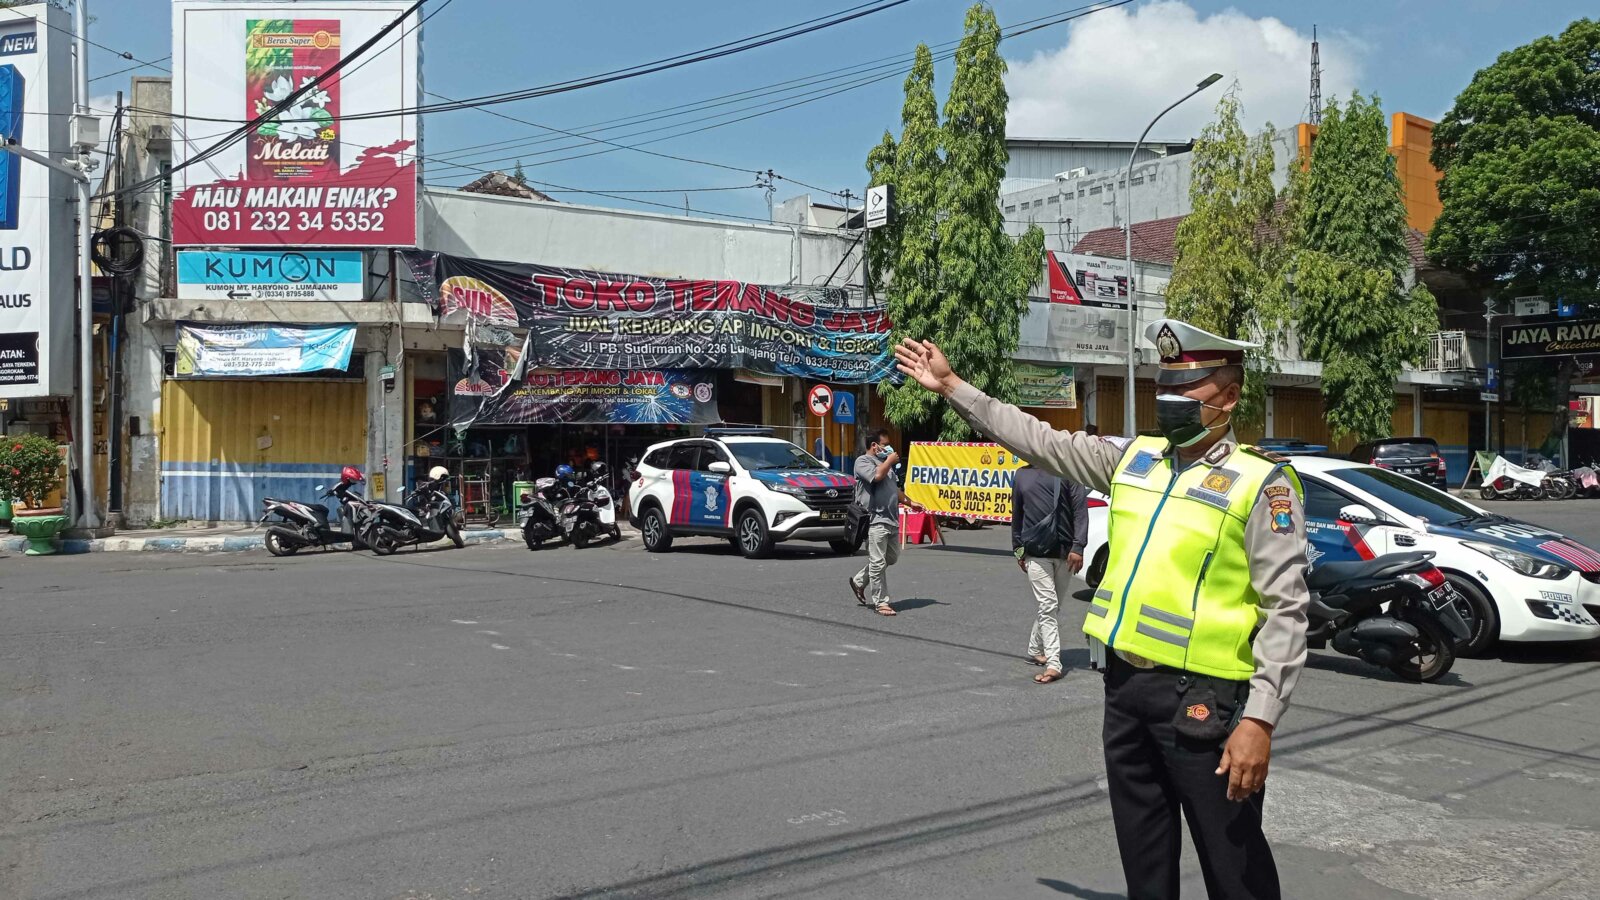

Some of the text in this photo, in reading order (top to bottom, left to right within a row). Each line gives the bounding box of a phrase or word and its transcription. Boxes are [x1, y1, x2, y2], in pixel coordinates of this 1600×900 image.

[3, 36, 37, 53] NEW
[266, 36, 311, 46] Beras Super
[253, 142, 330, 160] Melati
[191, 187, 398, 209] MAU MAKAN ENAK?
[203, 211, 385, 232] 081 232 34 5352
[205, 252, 336, 282] KUMON
[453, 286, 493, 317] SUN
[531, 272, 894, 334] TOKO TERANG JAYA
[563, 315, 882, 355] JUAL KEMBANG API IMPORT & LOKAL
[1507, 323, 1600, 345] JAYA RAYA
[599, 342, 622, 354] PB.
[624, 342, 682, 356] Sudirman
[685, 343, 705, 355] No.
[707, 343, 728, 354] 236
[730, 343, 777, 363] Lumajang
[778, 350, 801, 366] Telp.
[805, 355, 871, 372] 0334-8796442
[497, 369, 666, 387] TKO TERANG JAYA
[1487, 367, 1494, 385] P
[465, 382, 482, 394] SUN
[531, 387, 574, 396] KEMBANG
[576, 387, 589, 395] API
[591, 387, 621, 395] IMPORT
[622, 387, 630, 395] &
[631, 387, 657, 395] LOKAL
[638, 477, 645, 489] 9
[910, 466, 1017, 489] PEMBATASAN
[938, 489, 962, 501] PADA
[964, 490, 992, 503] MASA
[950, 500, 962, 510] 03
[963, 501, 985, 512] JULI
[993, 503, 1007, 514] 20
[1326, 523, 1351, 532] MELAYANI
[1540, 591, 1573, 603] POLICE
